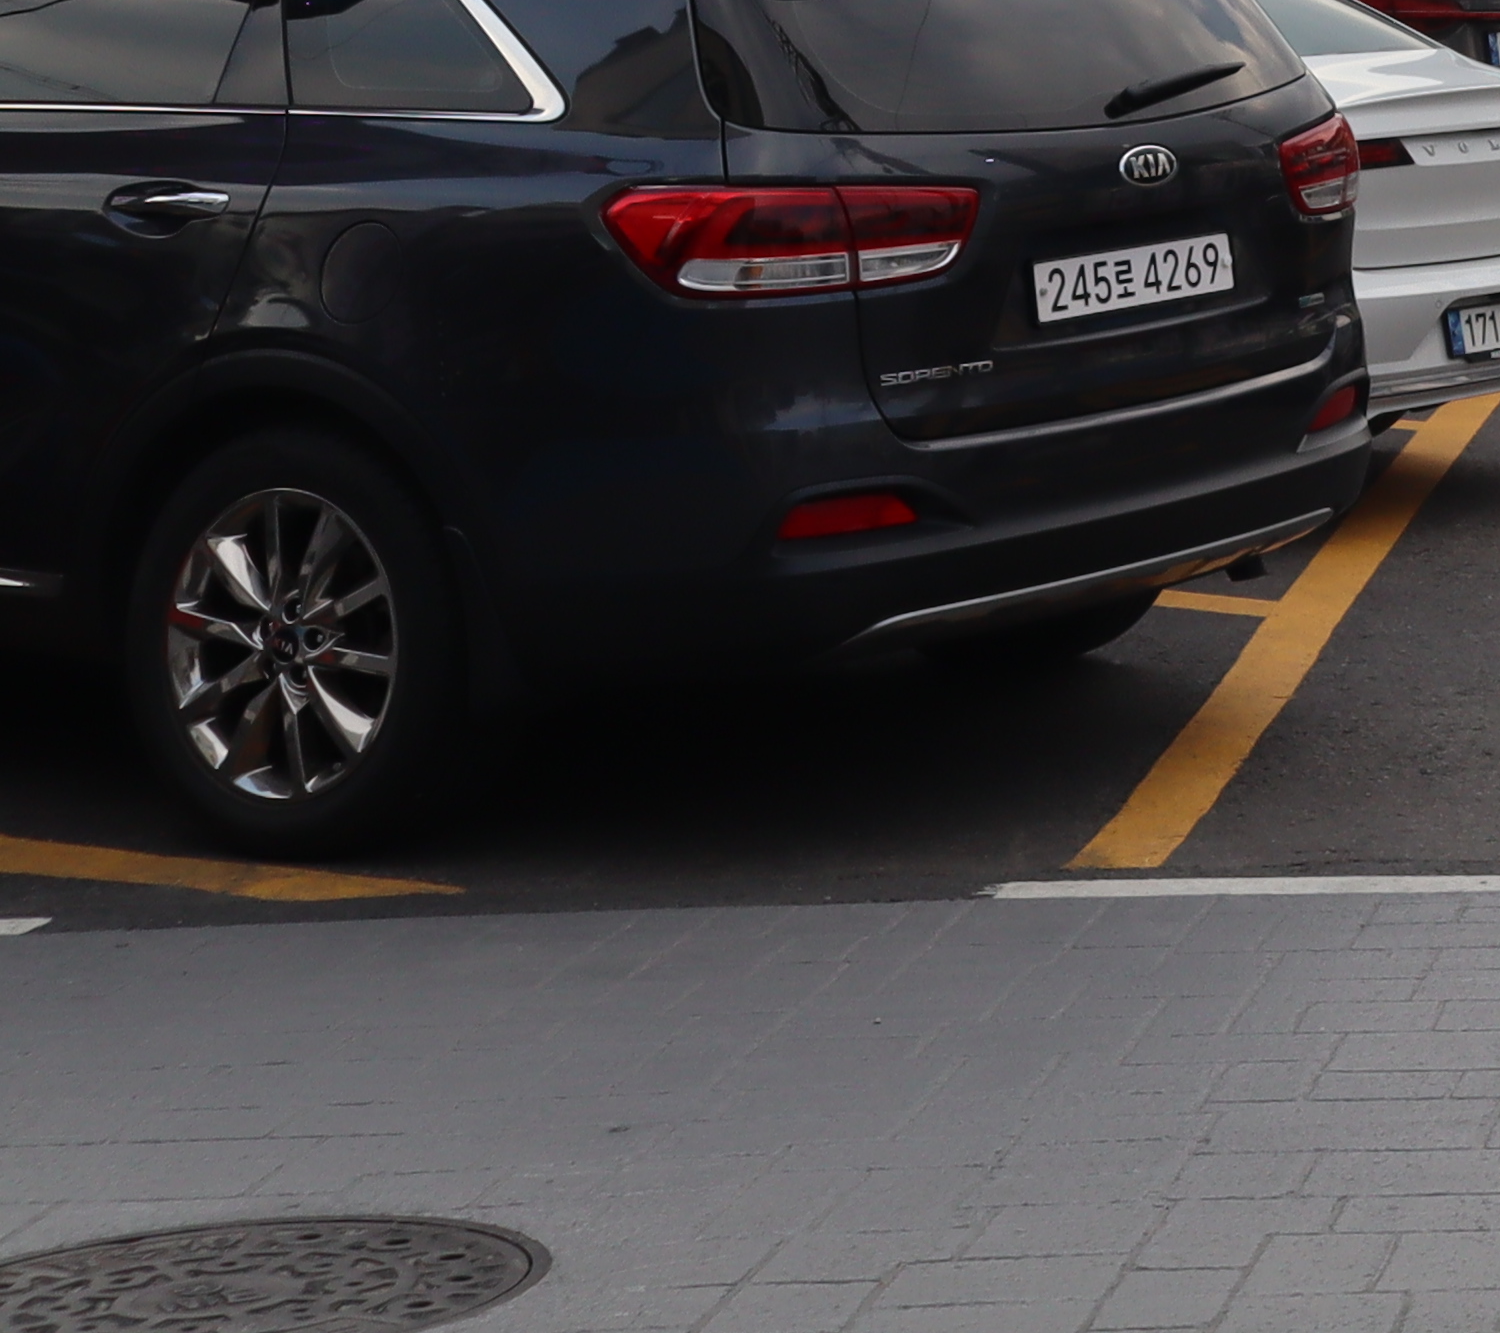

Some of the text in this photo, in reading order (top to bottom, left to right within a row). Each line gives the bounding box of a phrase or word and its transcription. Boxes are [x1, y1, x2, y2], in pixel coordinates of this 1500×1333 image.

[1127, 151, 1173, 182] KIA
[1047, 242, 1221, 314] 245로 4269
[879, 359, 994, 388] SORENTO
